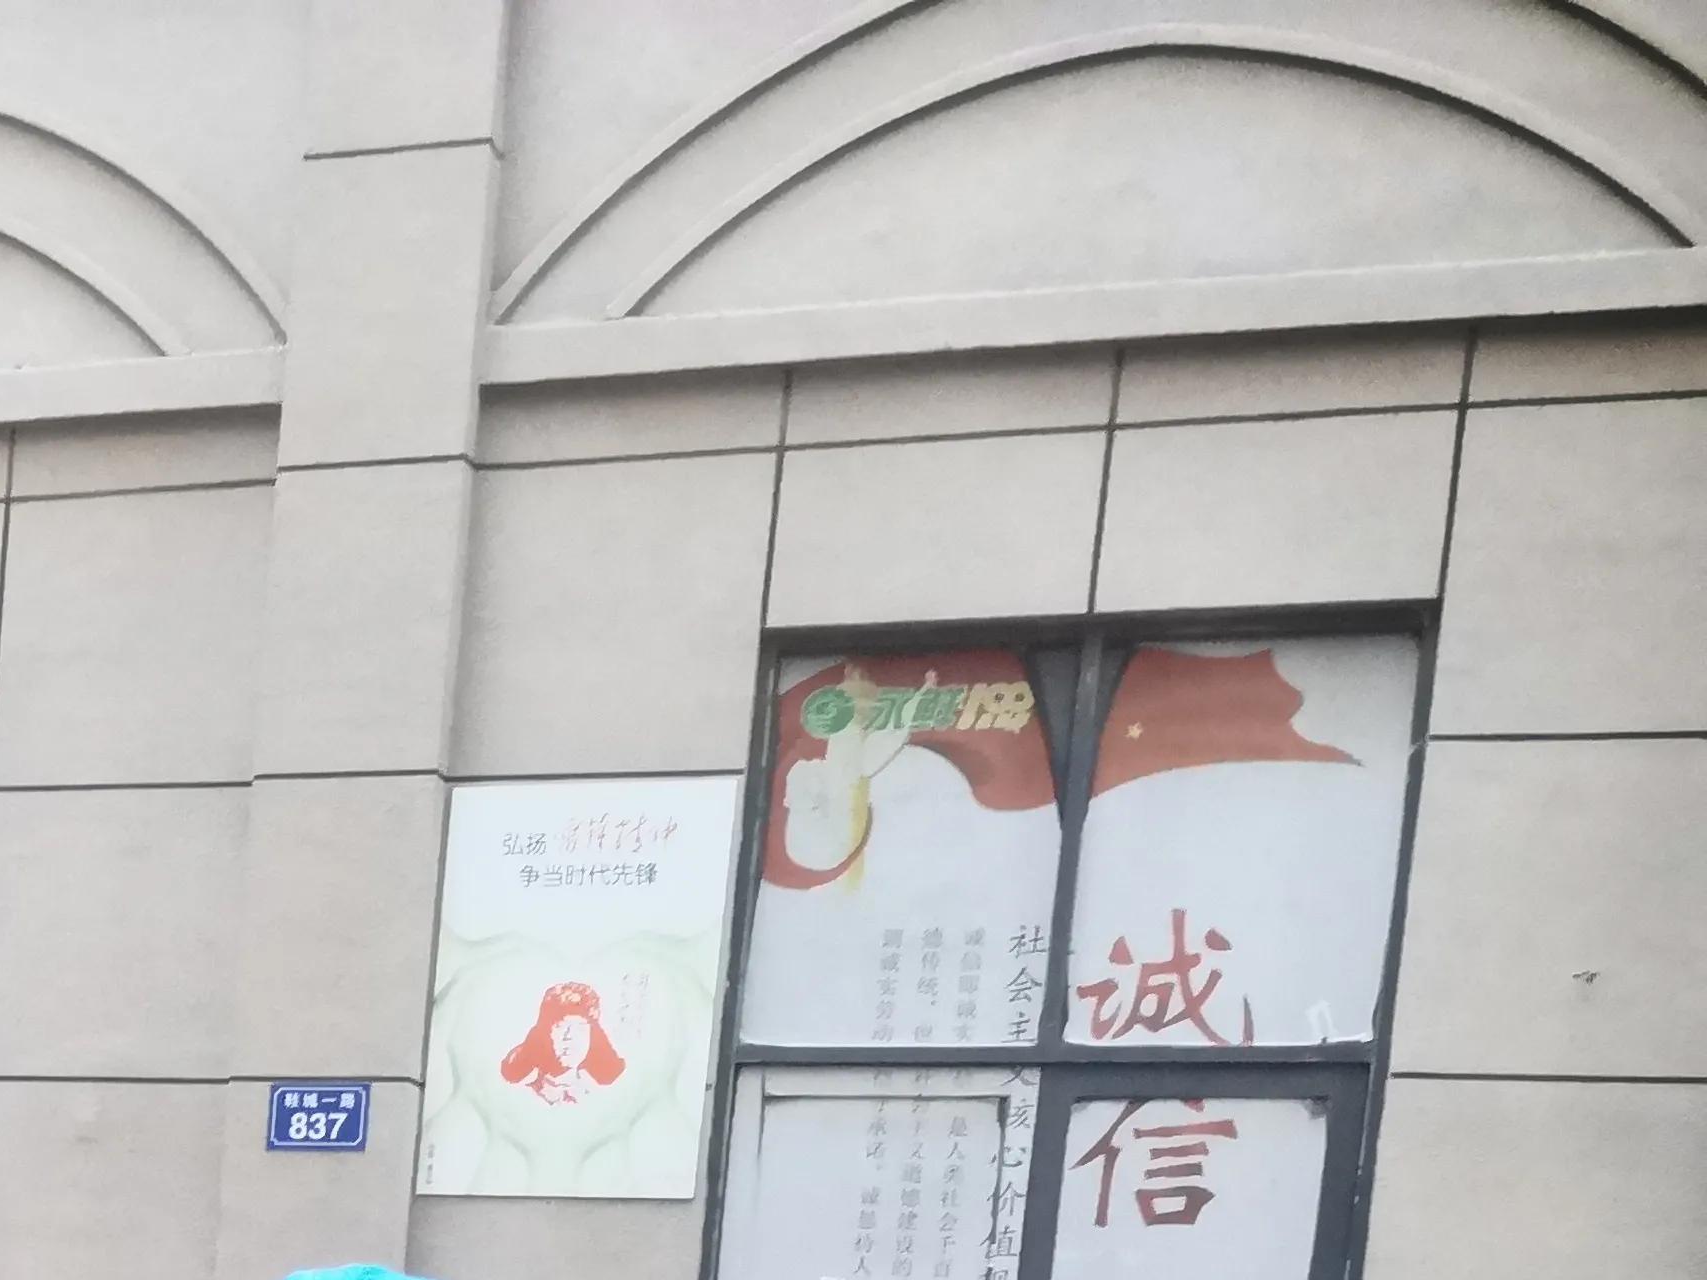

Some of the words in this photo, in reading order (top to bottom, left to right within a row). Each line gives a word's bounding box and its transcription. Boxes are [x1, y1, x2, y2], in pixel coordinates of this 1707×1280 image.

[501, 832, 548, 856] 弘扬
[519, 862, 659, 888] 争当时代先锋
[1068, 907, 1256, 1227] 诚信
[288, 1112, 349, 1140] 837
